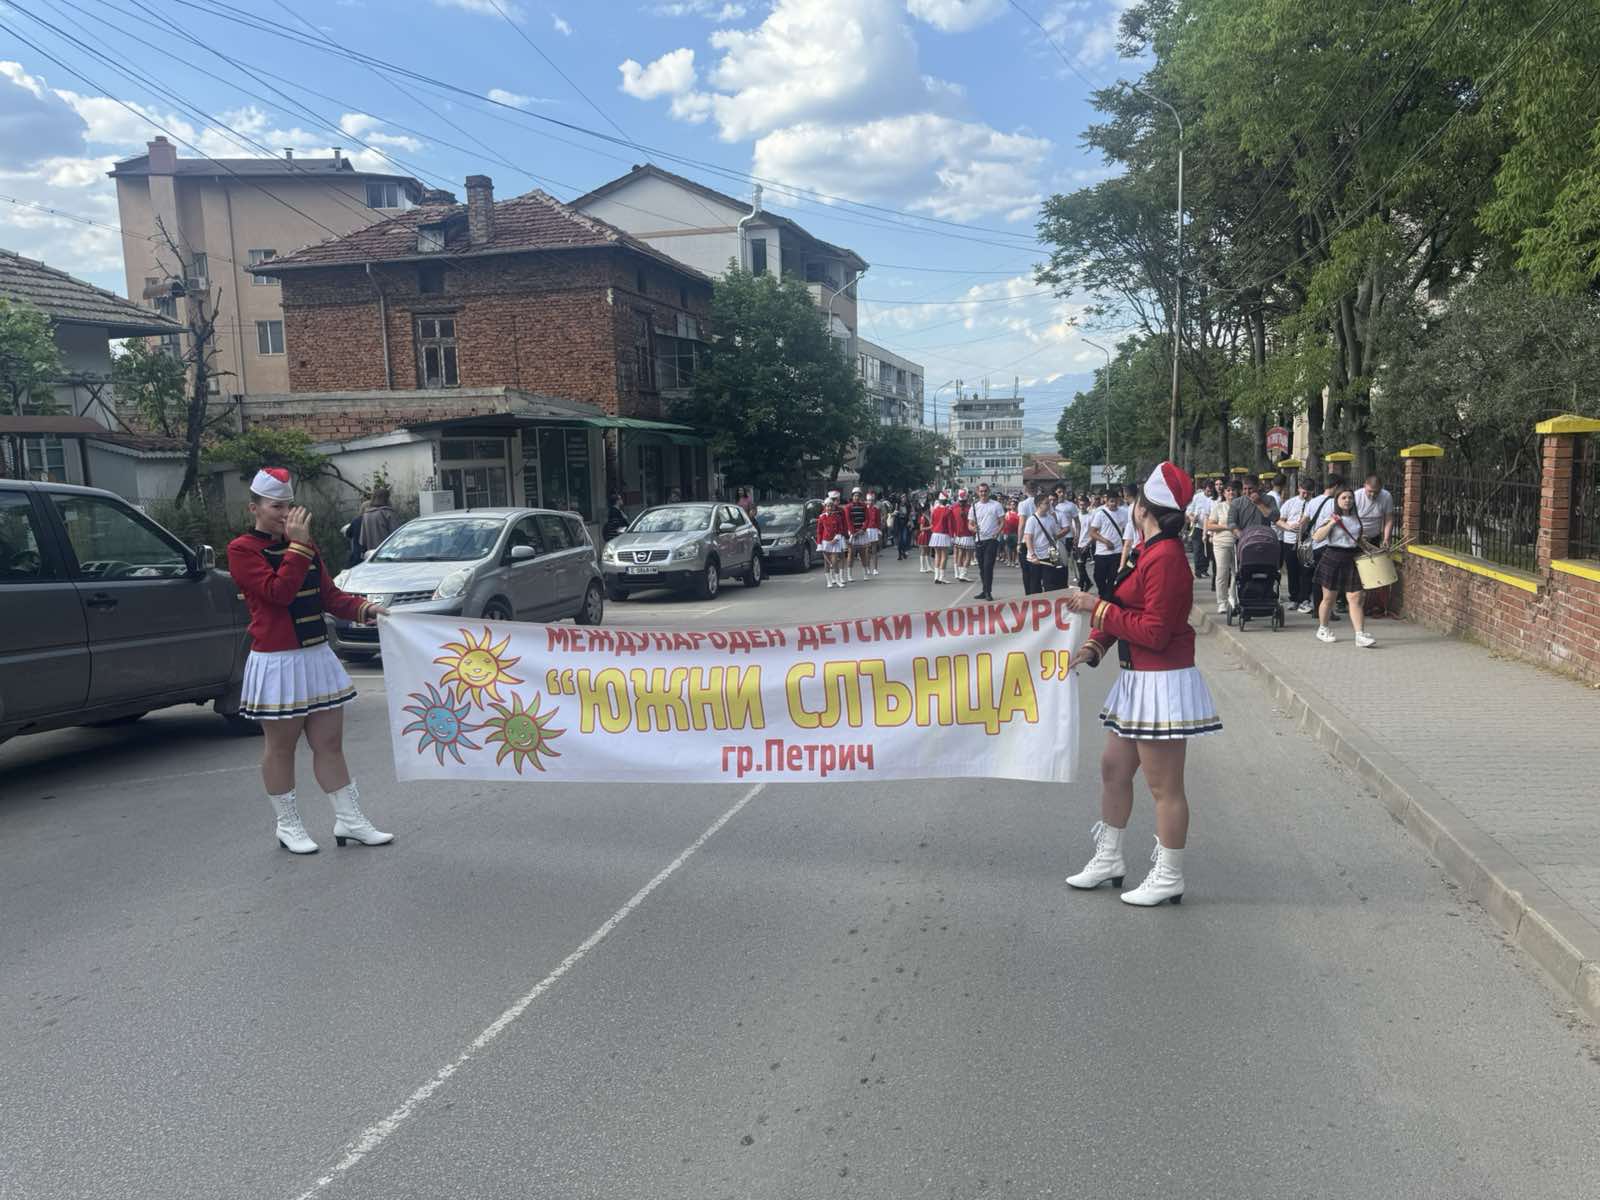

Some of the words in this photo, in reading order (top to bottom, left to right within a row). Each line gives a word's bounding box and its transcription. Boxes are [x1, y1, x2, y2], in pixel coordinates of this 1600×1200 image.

[546, 626, 786, 656] МЕЖДУНАРОДЕН
[798, 611, 912, 650] ДЕТСКИ
[925, 597, 1071, 638] КОНКУРС
[546, 665, 765, 733] “ЮЖНИ
[785, 650, 1070, 735] СЛЪНЦА”
[722, 739, 874, 777] гр.Петрич
